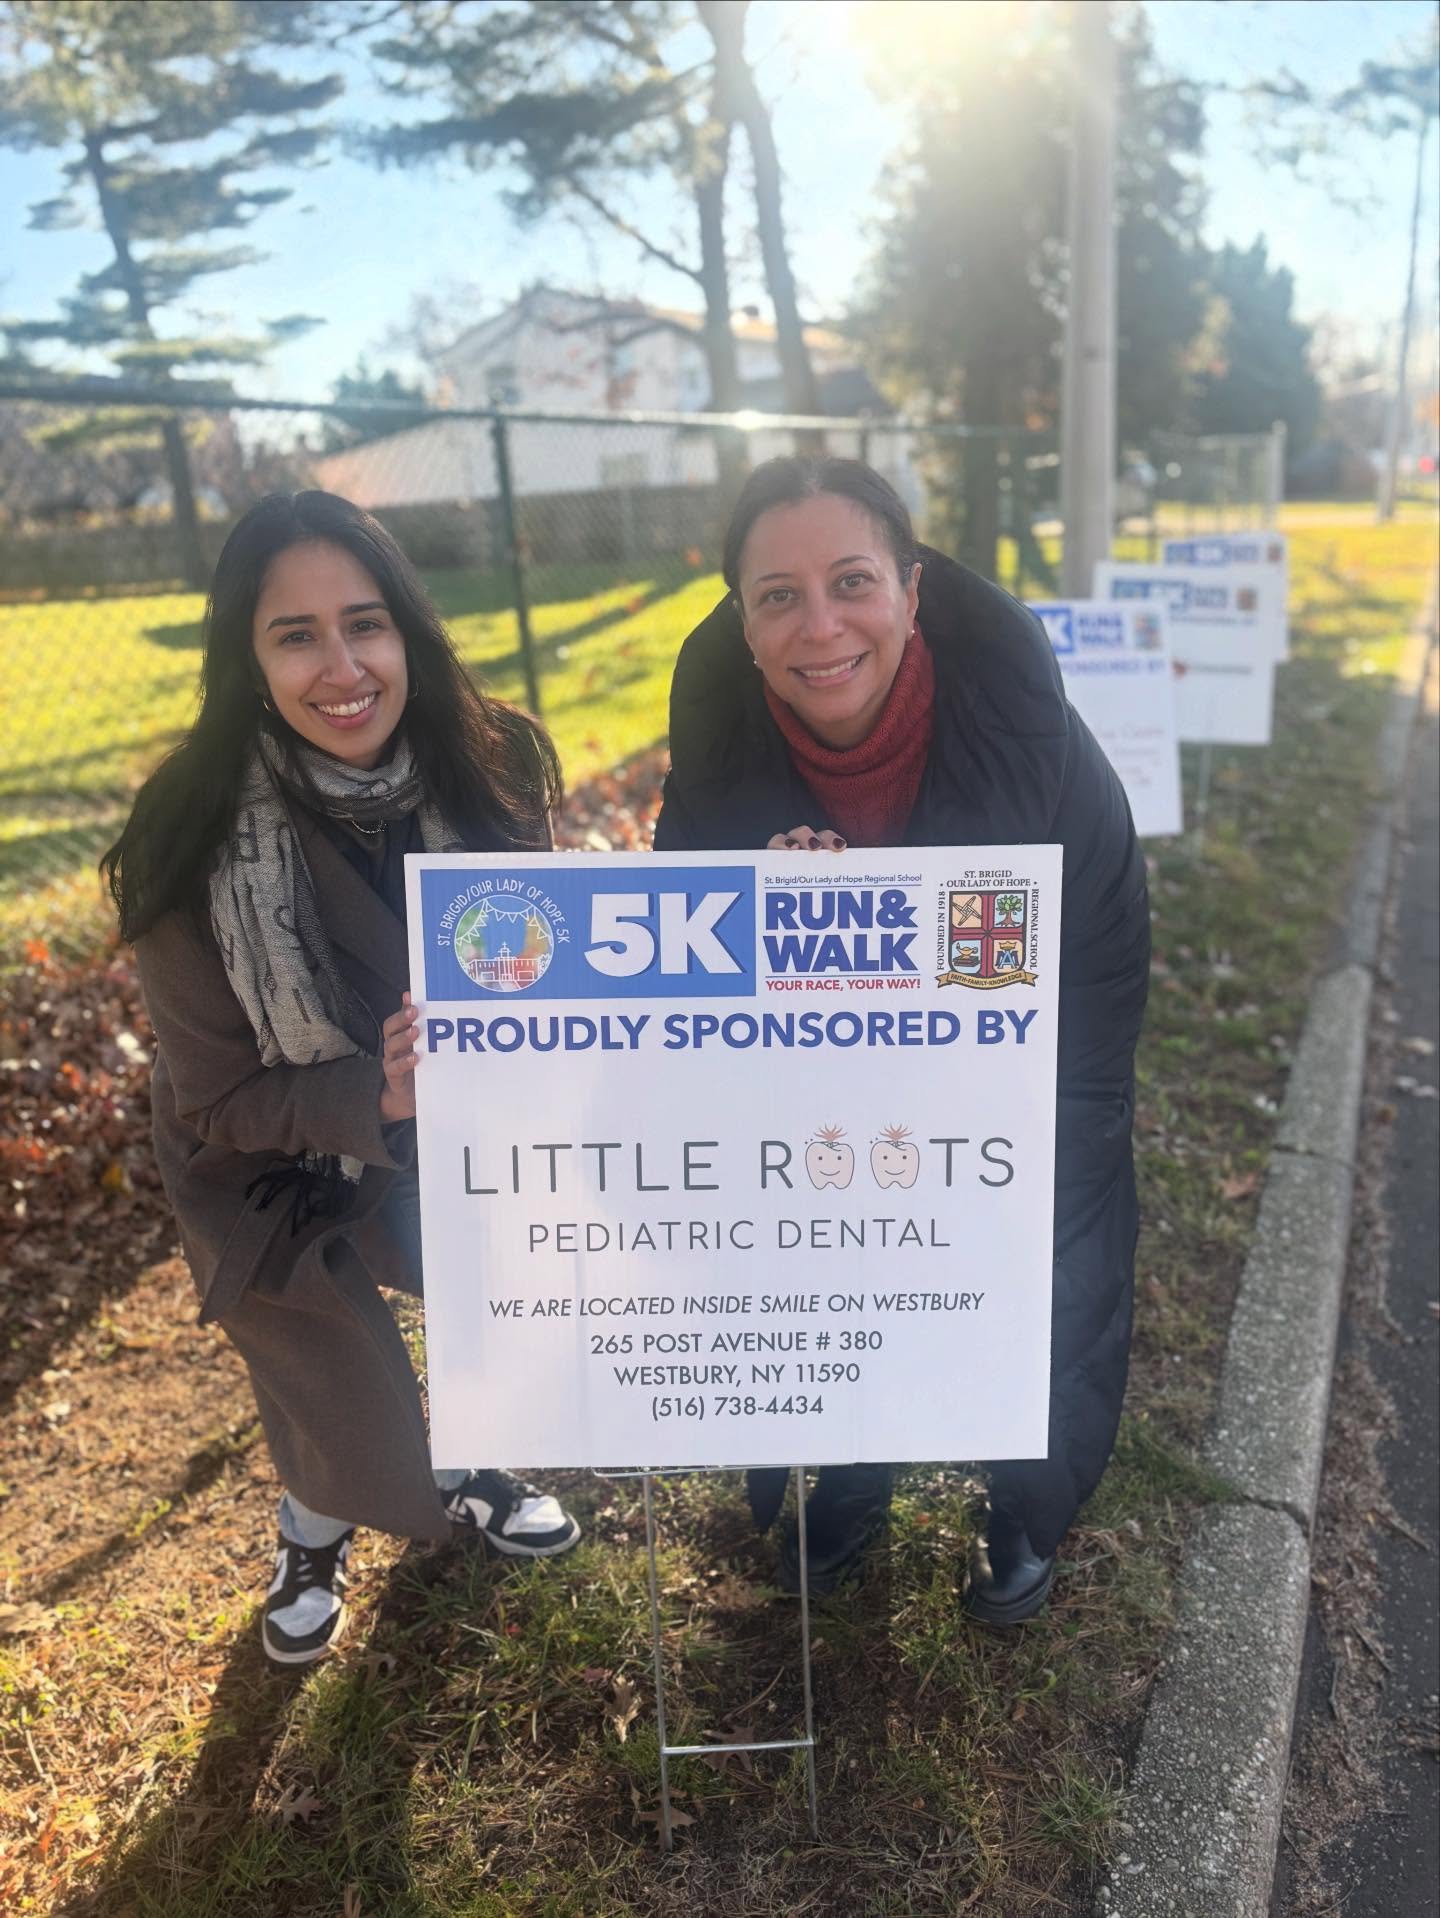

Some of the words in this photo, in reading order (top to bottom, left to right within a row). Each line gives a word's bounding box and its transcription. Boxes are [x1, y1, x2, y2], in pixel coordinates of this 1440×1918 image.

[496, 879, 525, 894] LADY
[764, 876, 774, 884] St.
[775, 876, 814, 886] Brigid/Our
[815, 875, 832, 884] Lady
[834, 875, 842, 883] of
[842, 875, 862, 884] Hope
[864, 874, 896, 884] Regional
[897, 874, 922, 882] School
[946, 880, 966, 888] OUR
[967, 880, 991, 888] LADY
[1006, 878, 1031, 886] HOPE
[964, 870, 976, 878] ST.
[978, 870, 1012, 878] BRIGID
[440, 880, 493, 930] BRIGID/OUR
[526, 886, 543, 900] OF
[938, 891, 946, 910] 1918
[540, 896, 566, 926] HOPE
[766, 889, 918, 930] RUN&
[938, 912, 945, 924] IN
[1030, 888, 1039, 933] REGIONAL
[438, 933, 452, 946] ST.
[556, 928, 570, 944] 5K
[584, 891, 746, 978] 5K
[762, 933, 918, 972] WALK
[936, 926, 945, 970] FOUNDED
[1030, 934, 1038, 970] SCHOOL
[766, 980, 802, 991] YOUR
[806, 979, 844, 992] RACE,
[846, 978, 884, 990] YOUR
[886, 978, 920, 989] WAY!
[426, 1014, 651, 1053] PROUDLY
[663, 1010, 961, 1049] SPONSORED
[977, 1009, 1039, 1045] BY
[464, 1141, 719, 1194] LITTLE
[530, 1220, 754, 1252] PEDIATRIC
[778, 1218, 950, 1249] DENTAL
[489, 1299, 524, 1318] WE
[531, 1298, 573, 1318] ARE
[579, 1297, 675, 1316] LOCATED
[683, 1296, 752, 1314] INSIDE
[760, 1294, 820, 1313] SMILE
[828, 1294, 865, 1312] ON
[872, 1292, 985, 1312] WESTBURY
[590, 1334, 633, 1354] 265
[643, 1333, 702, 1353] POST
[710, 1331, 808, 1352] AVENUE
[816, 1331, 831, 1351] #
[839, 1330, 883, 1351] 380
[613, 1364, 741, 1388] WESTBURY,
[752, 1363, 786, 1384] NY
[796, 1362, 860, 1382] 11590
[652, 1396, 705, 1421] (516)
[714, 1394, 824, 1416] 738-4434
